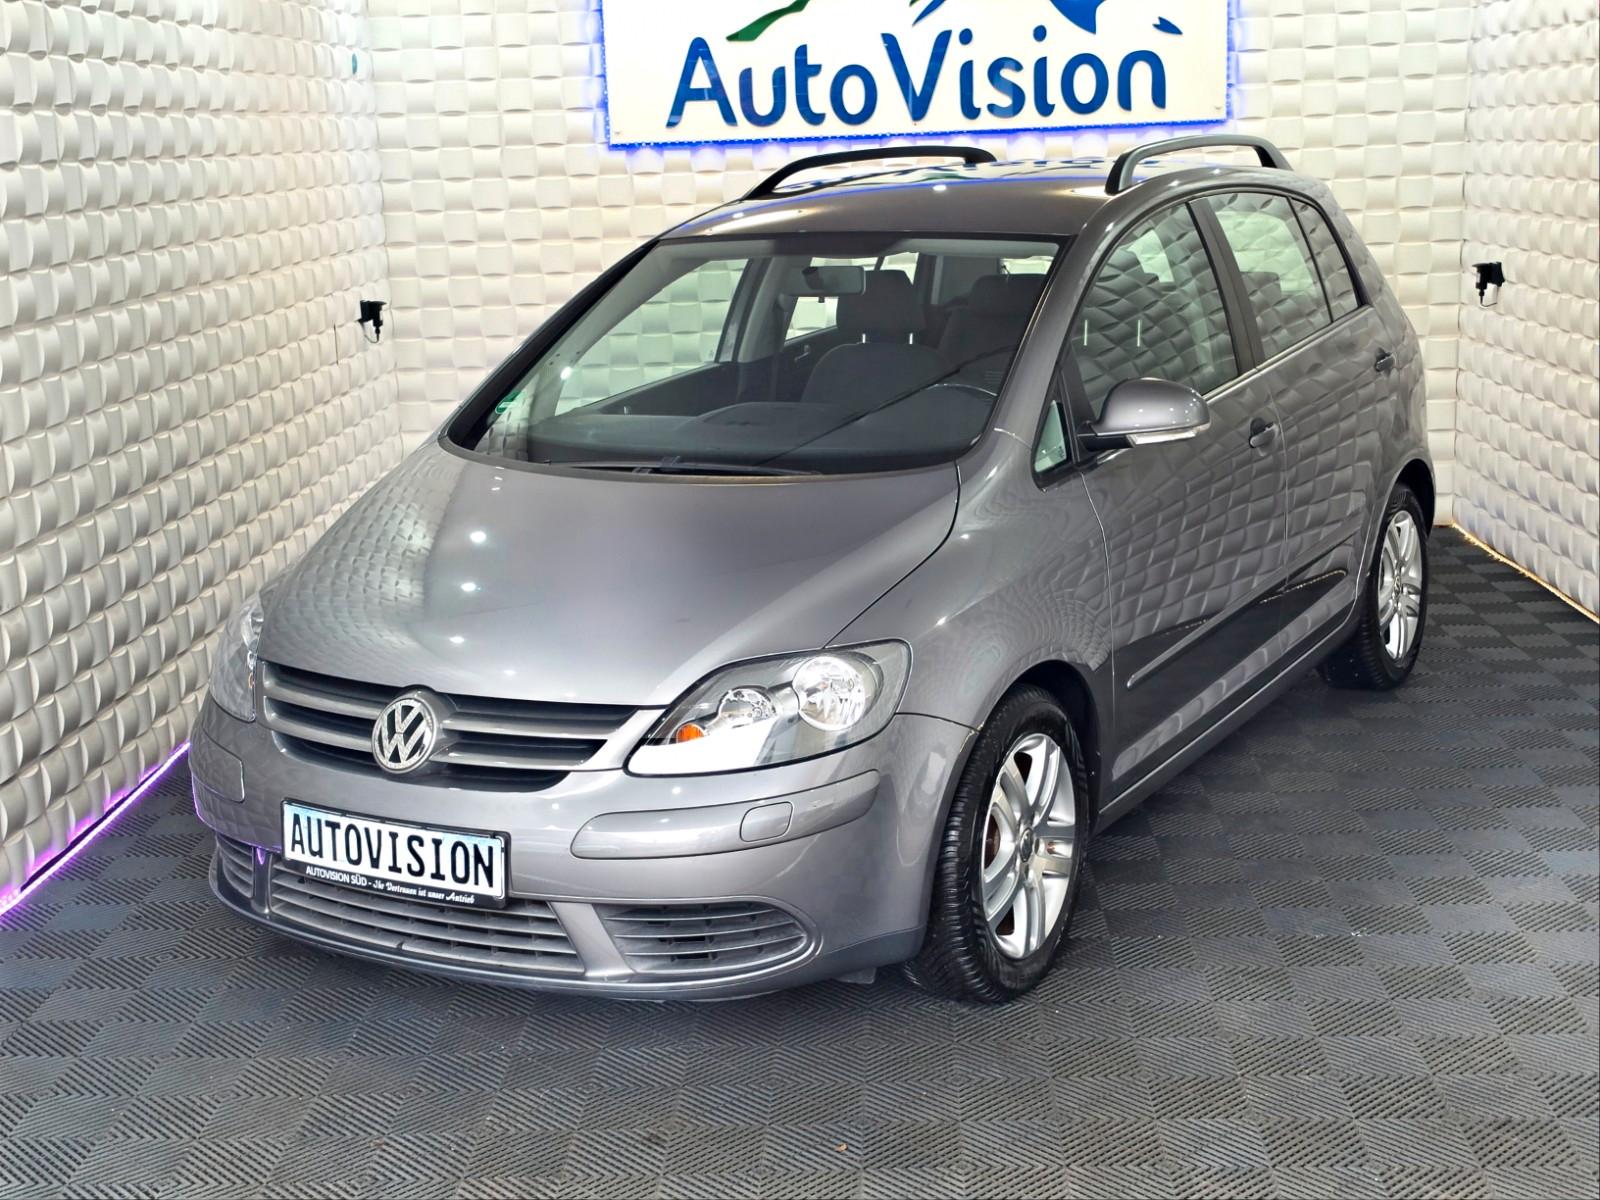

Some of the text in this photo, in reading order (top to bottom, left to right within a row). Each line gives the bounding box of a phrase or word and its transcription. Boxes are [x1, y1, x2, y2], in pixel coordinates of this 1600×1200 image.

[666, 24, 1166, 128] AutoVision
[291, 813, 493, 887] AUTOVISION
[306, 865, 349, 883] AUTOVISION
[350, 873, 368, 886] SÜD
